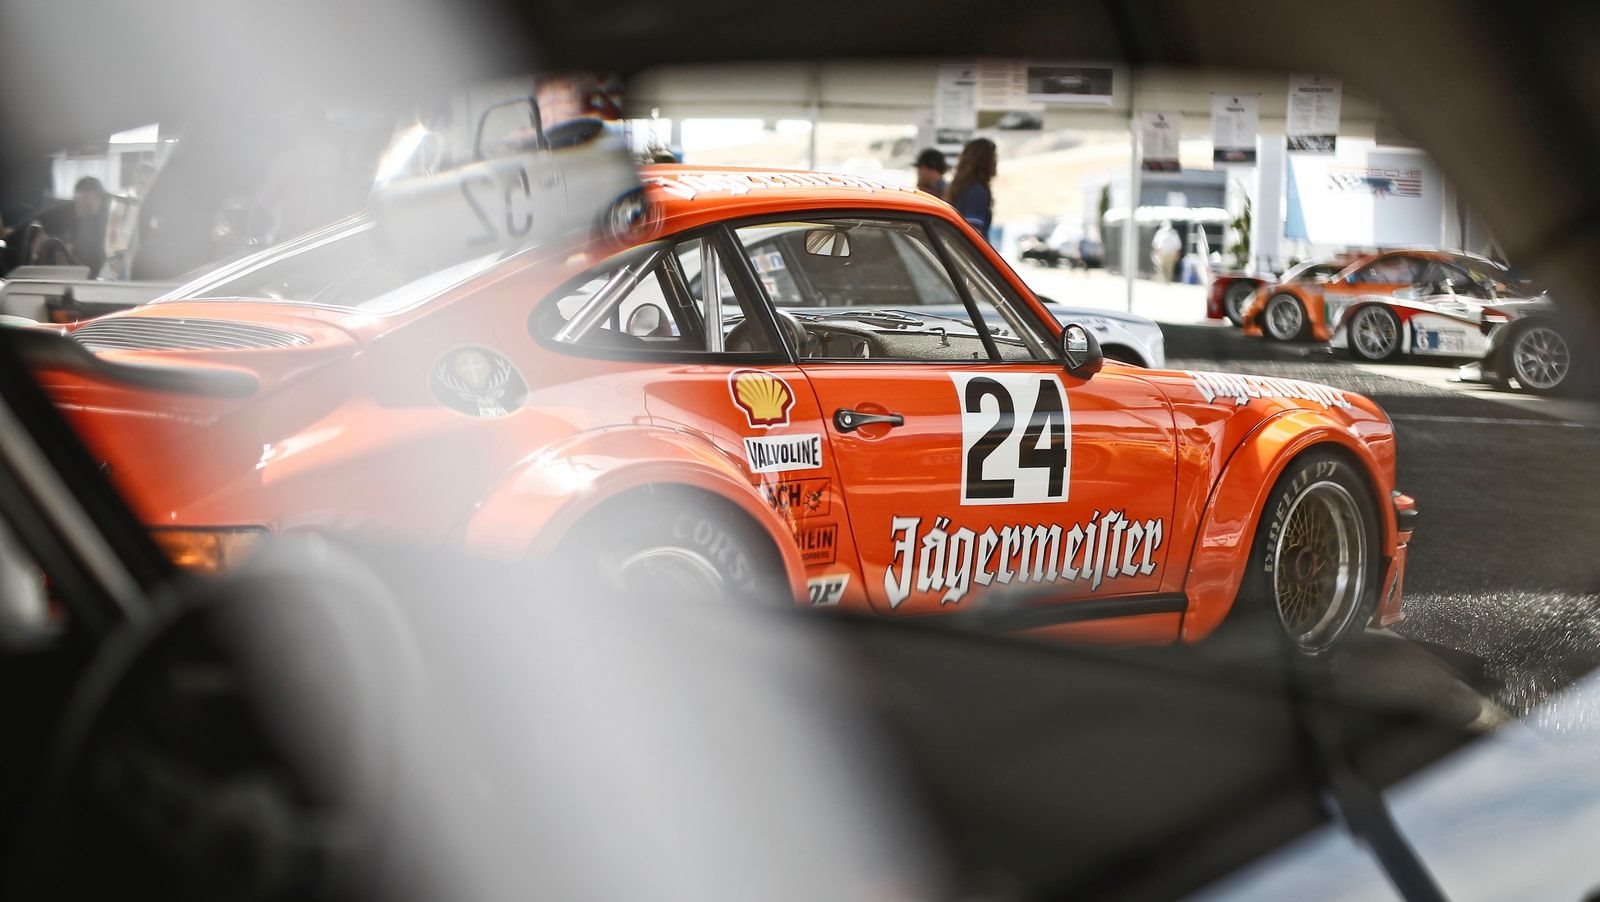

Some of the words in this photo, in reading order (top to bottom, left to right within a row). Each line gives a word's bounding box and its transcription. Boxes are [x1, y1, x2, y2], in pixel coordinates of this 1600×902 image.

[745, 436, 820, 470] VALVOLINE
[965, 376, 1067, 499] 24
[884, 509, 1163, 608] Jägermeister
[1263, 469, 1308, 572] PIRELLI
